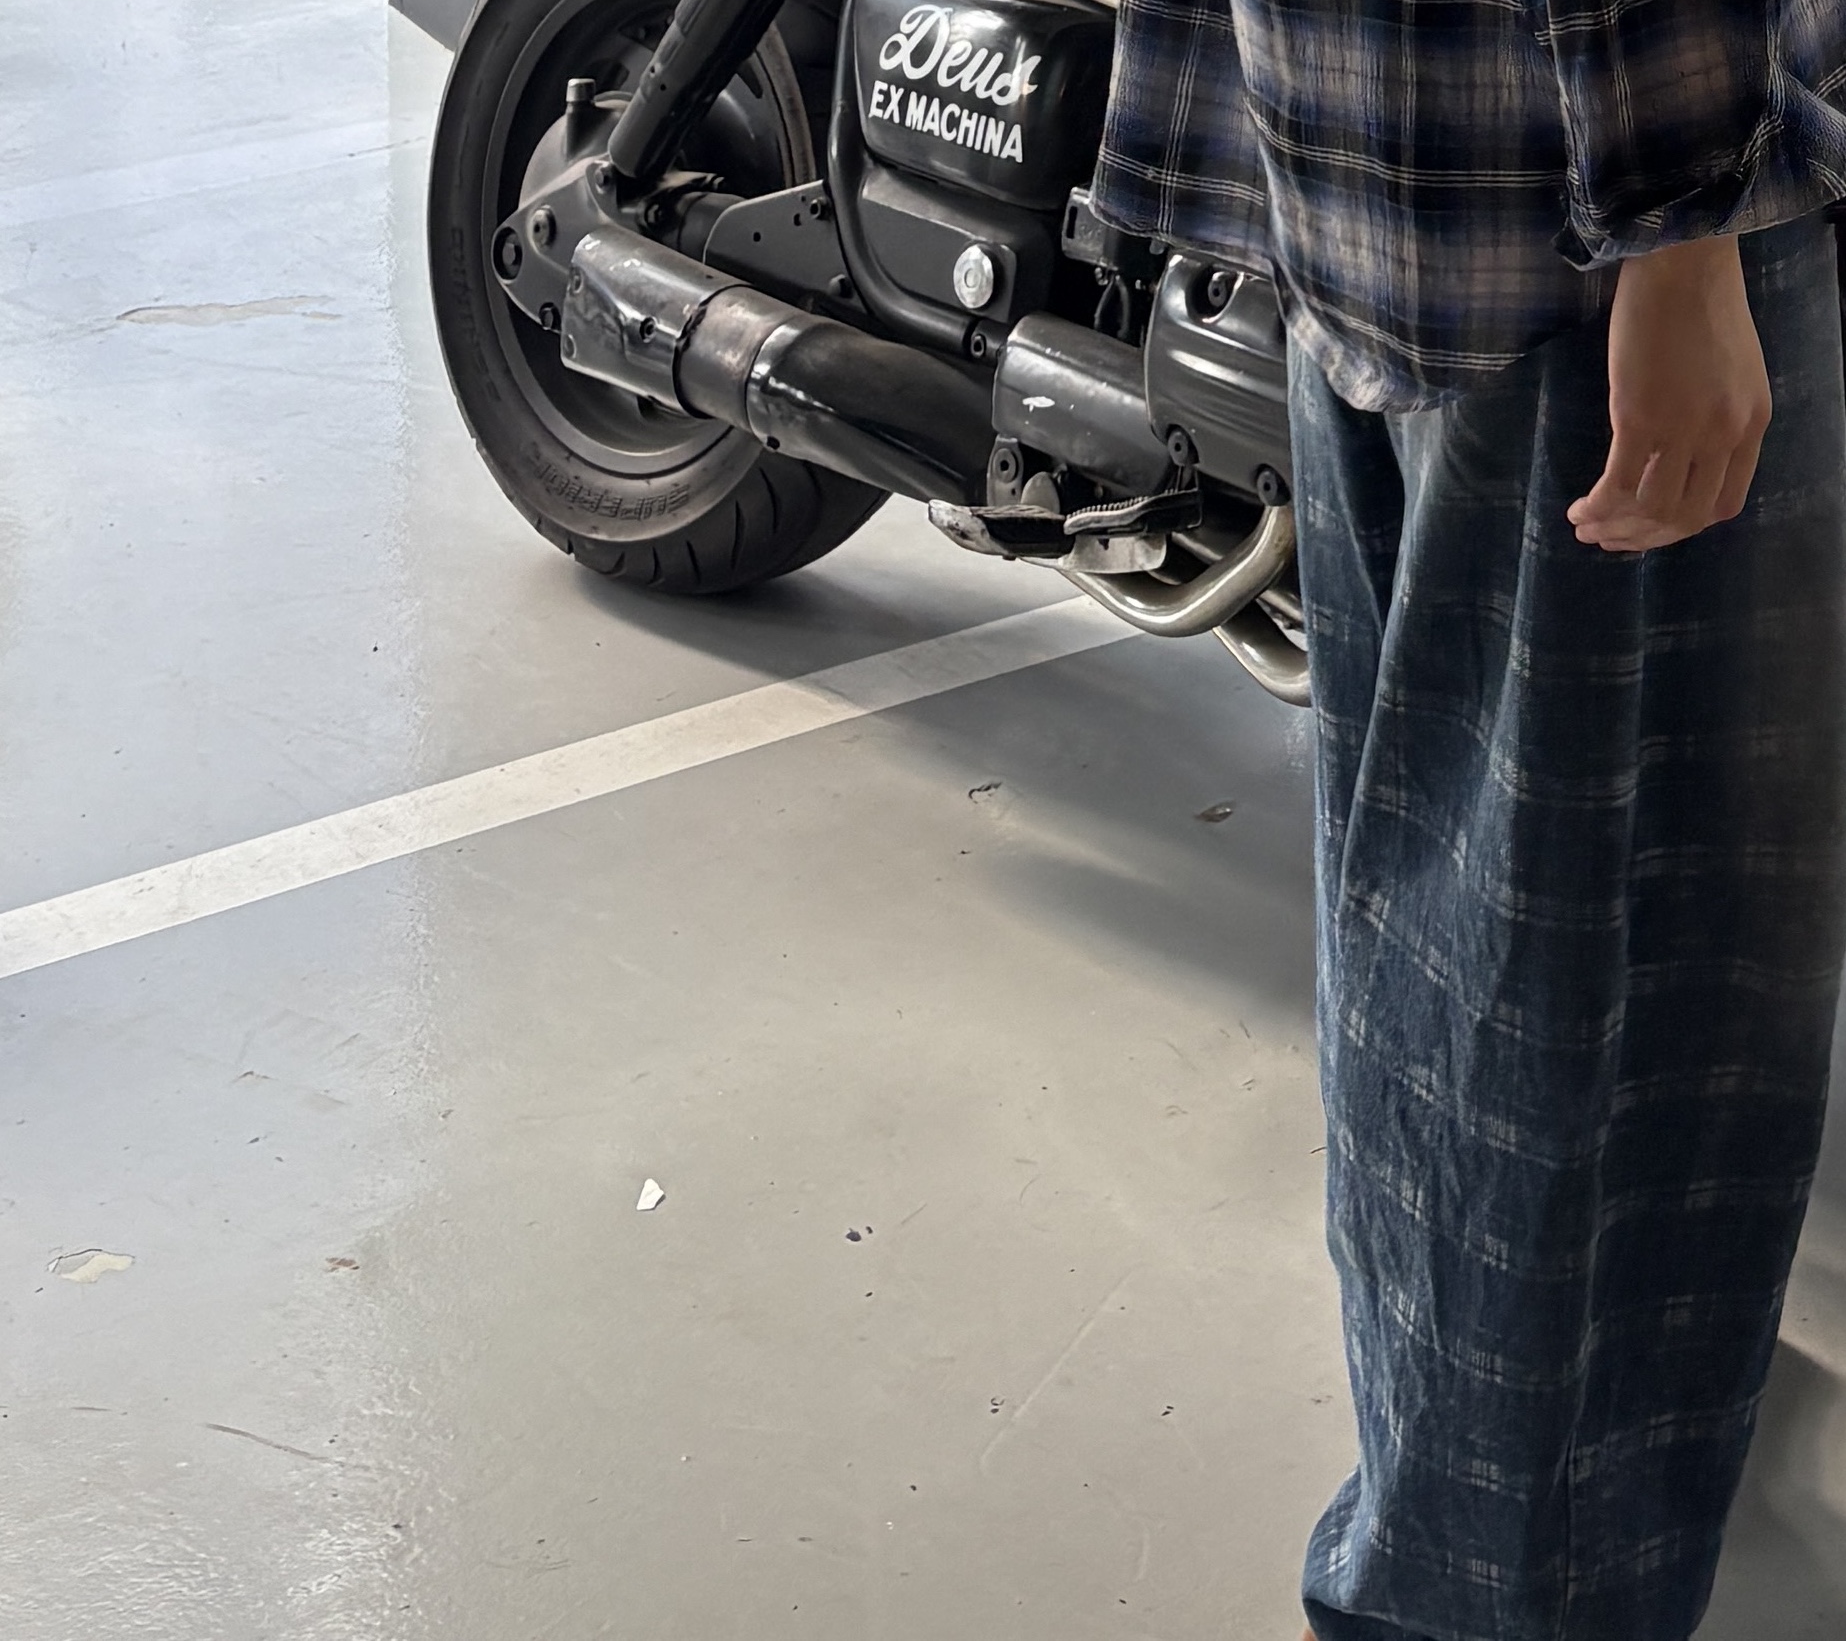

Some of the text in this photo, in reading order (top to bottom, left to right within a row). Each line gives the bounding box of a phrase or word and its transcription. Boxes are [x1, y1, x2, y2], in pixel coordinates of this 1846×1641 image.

[879, 4, 1041, 106] Deus
[868, 79, 1023, 163] EX MACHINA
